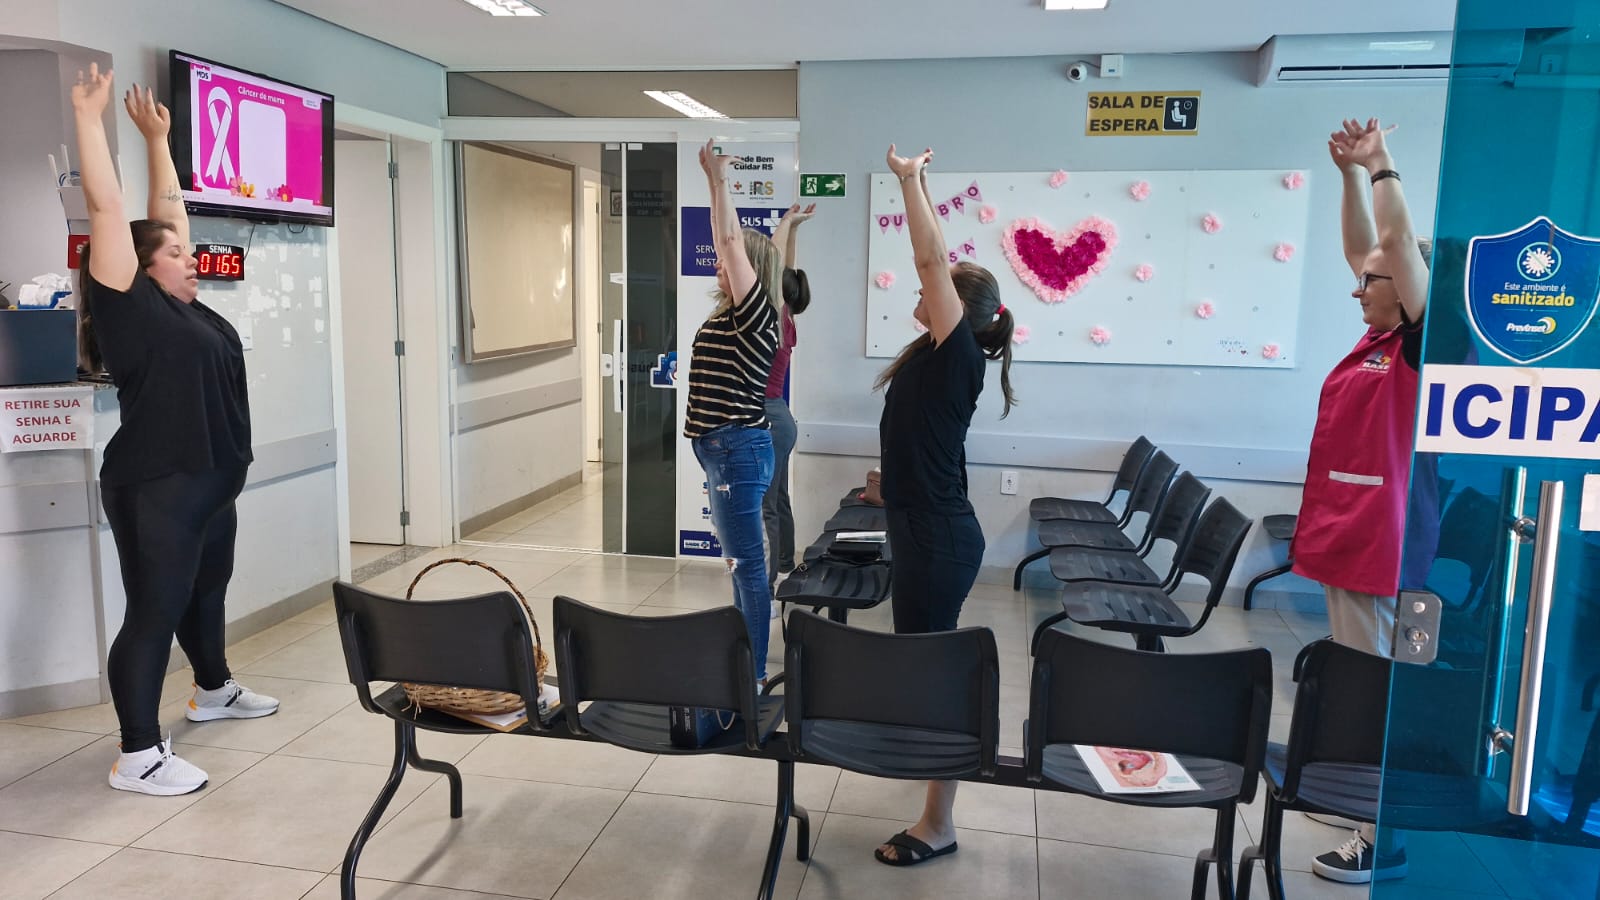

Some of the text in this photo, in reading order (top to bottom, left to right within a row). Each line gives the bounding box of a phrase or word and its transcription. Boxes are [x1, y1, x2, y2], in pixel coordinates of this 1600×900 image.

[237, 85, 285, 105] Câncer de mama
[1088, 95, 1164, 109] SALA DE
[1090, 118, 1159, 131] ESPERA
[756, 155, 774, 163] Bem
[879, 186, 979, 227] OUBRO
[741, 216, 761, 227] SUS
[209, 244, 232, 255] SENHA
[200, 253, 240, 275] 0165
[695, 257, 717, 266] NEST
[1504, 282, 1567, 292] Este ambiente é
[1491, 291, 1575, 306] sanitizado
[5, 399, 81, 410] RETIRE SUA
[16, 415, 71, 427] SENHA E
[12, 432, 77, 444] AGUARDE
